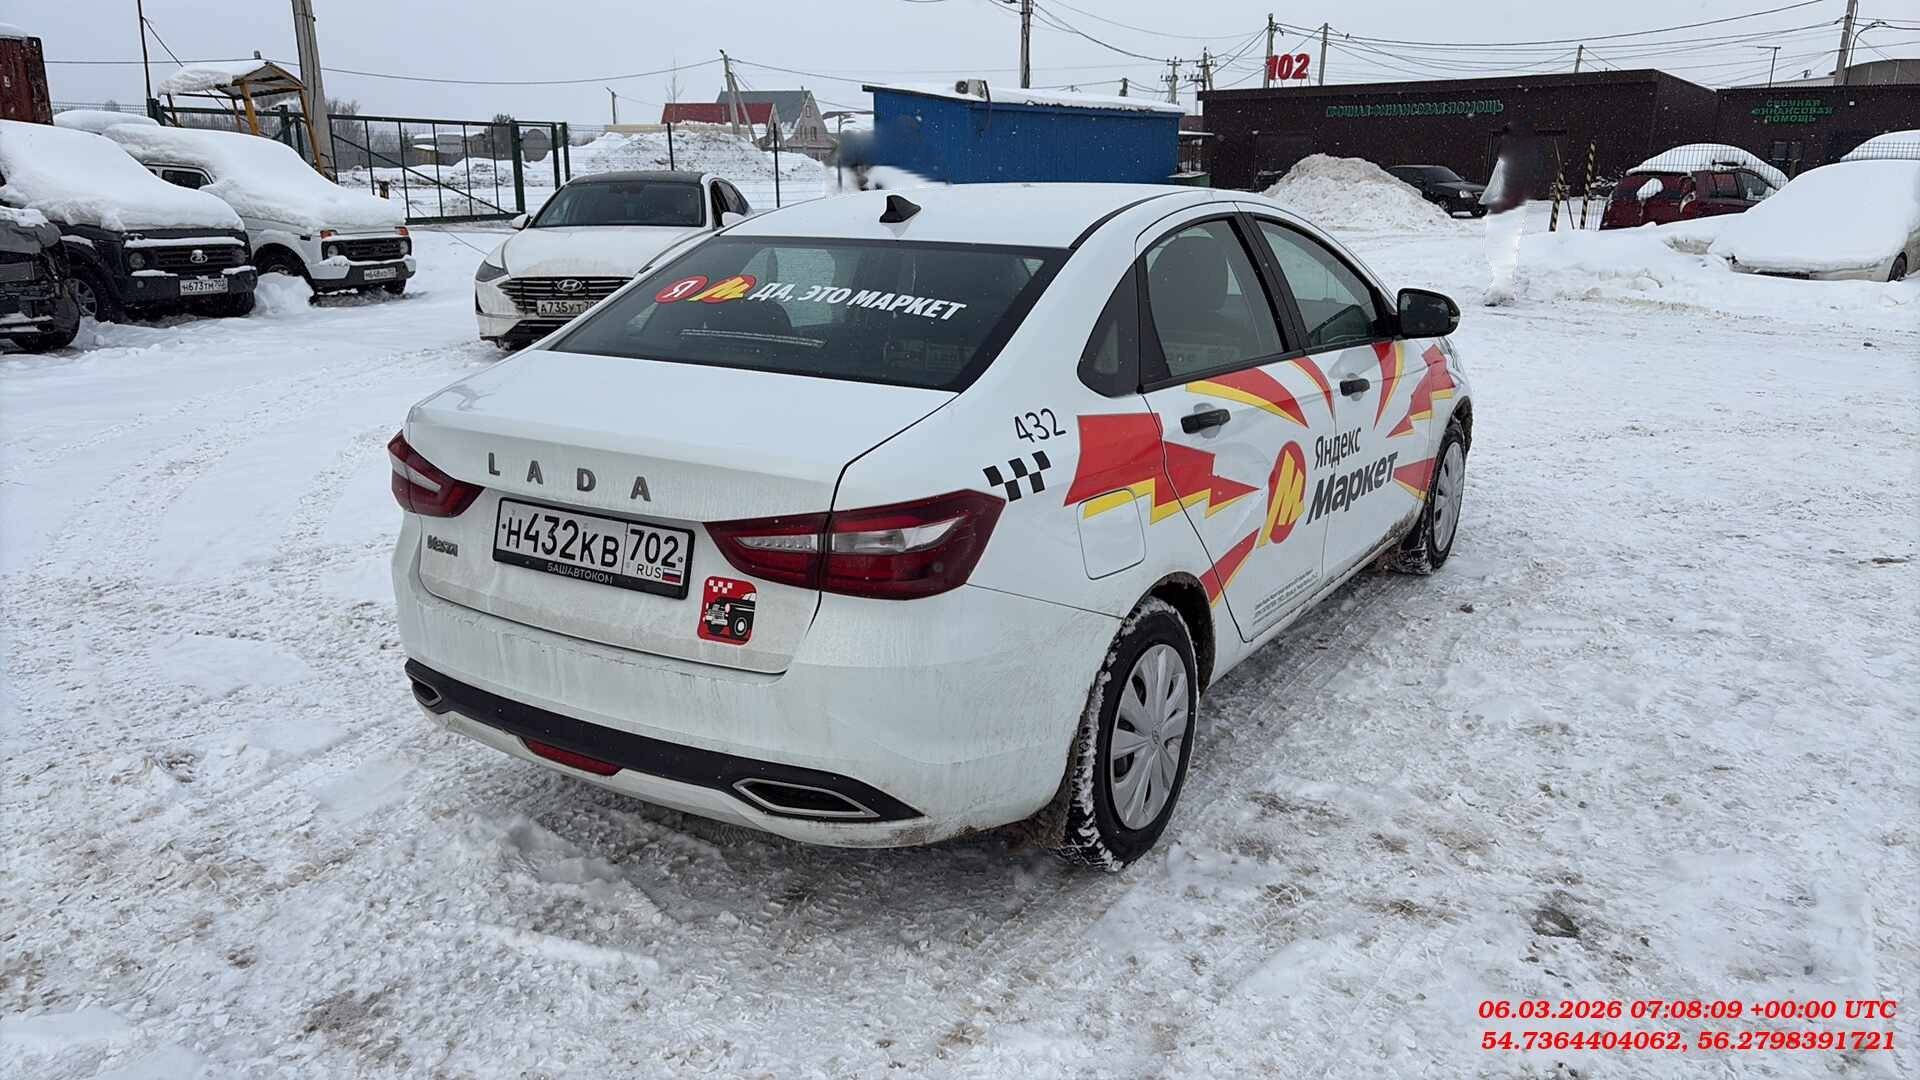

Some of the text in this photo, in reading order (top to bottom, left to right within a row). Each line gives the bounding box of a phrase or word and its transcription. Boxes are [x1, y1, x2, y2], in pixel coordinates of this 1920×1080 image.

[1268, 53, 1310, 80] 102
[747, 282, 796, 302] ДА,
[798, 284, 852, 304] ЭТО
[846, 288, 968, 321] МАРКЕТ
[1014, 408, 1067, 443] 432
[1314, 427, 1361, 470] Яндекс
[487, 451, 652, 502] LADA
[1306, 451, 1399, 525] Маркет
[636, 563, 662, 579] RUS
